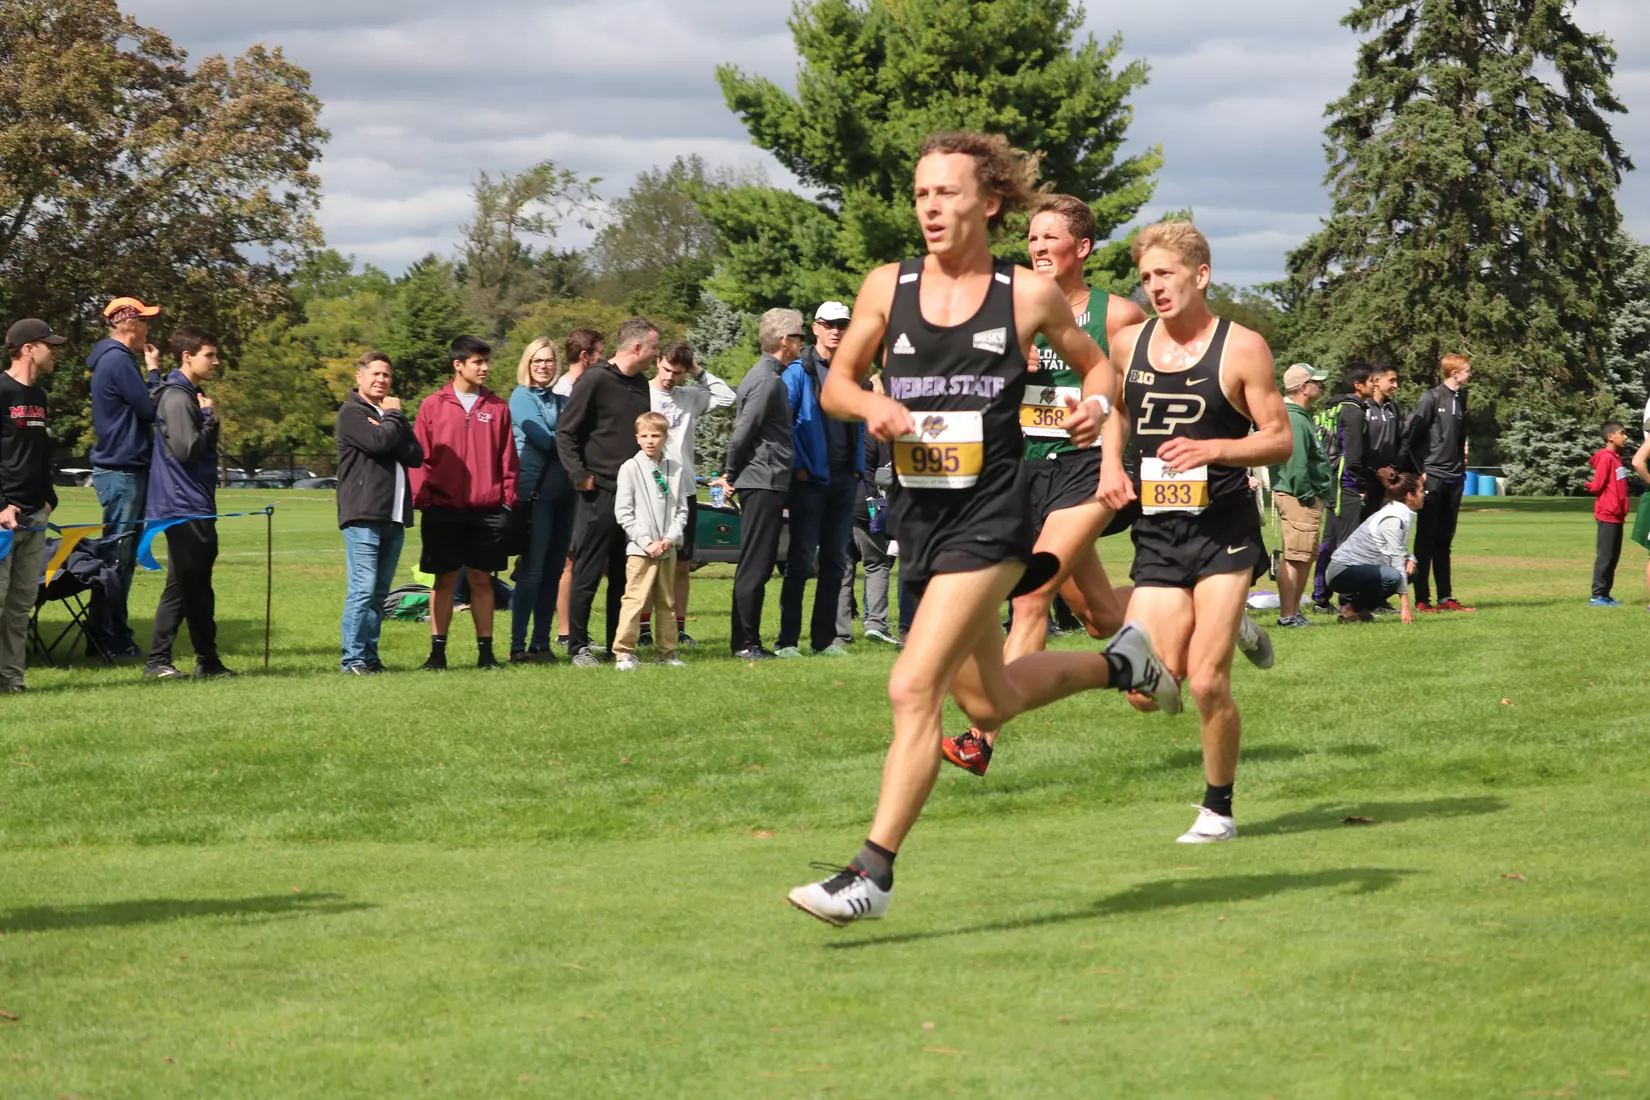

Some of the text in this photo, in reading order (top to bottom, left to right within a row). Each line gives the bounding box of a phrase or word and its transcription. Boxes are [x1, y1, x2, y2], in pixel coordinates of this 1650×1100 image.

[890, 374, 1005, 400] WEBER STATE
[1033, 408, 1065, 426] 368
[1137, 392, 1206, 435] P
[911, 446, 960, 473] 995
[1154, 484, 1192, 505] 833
